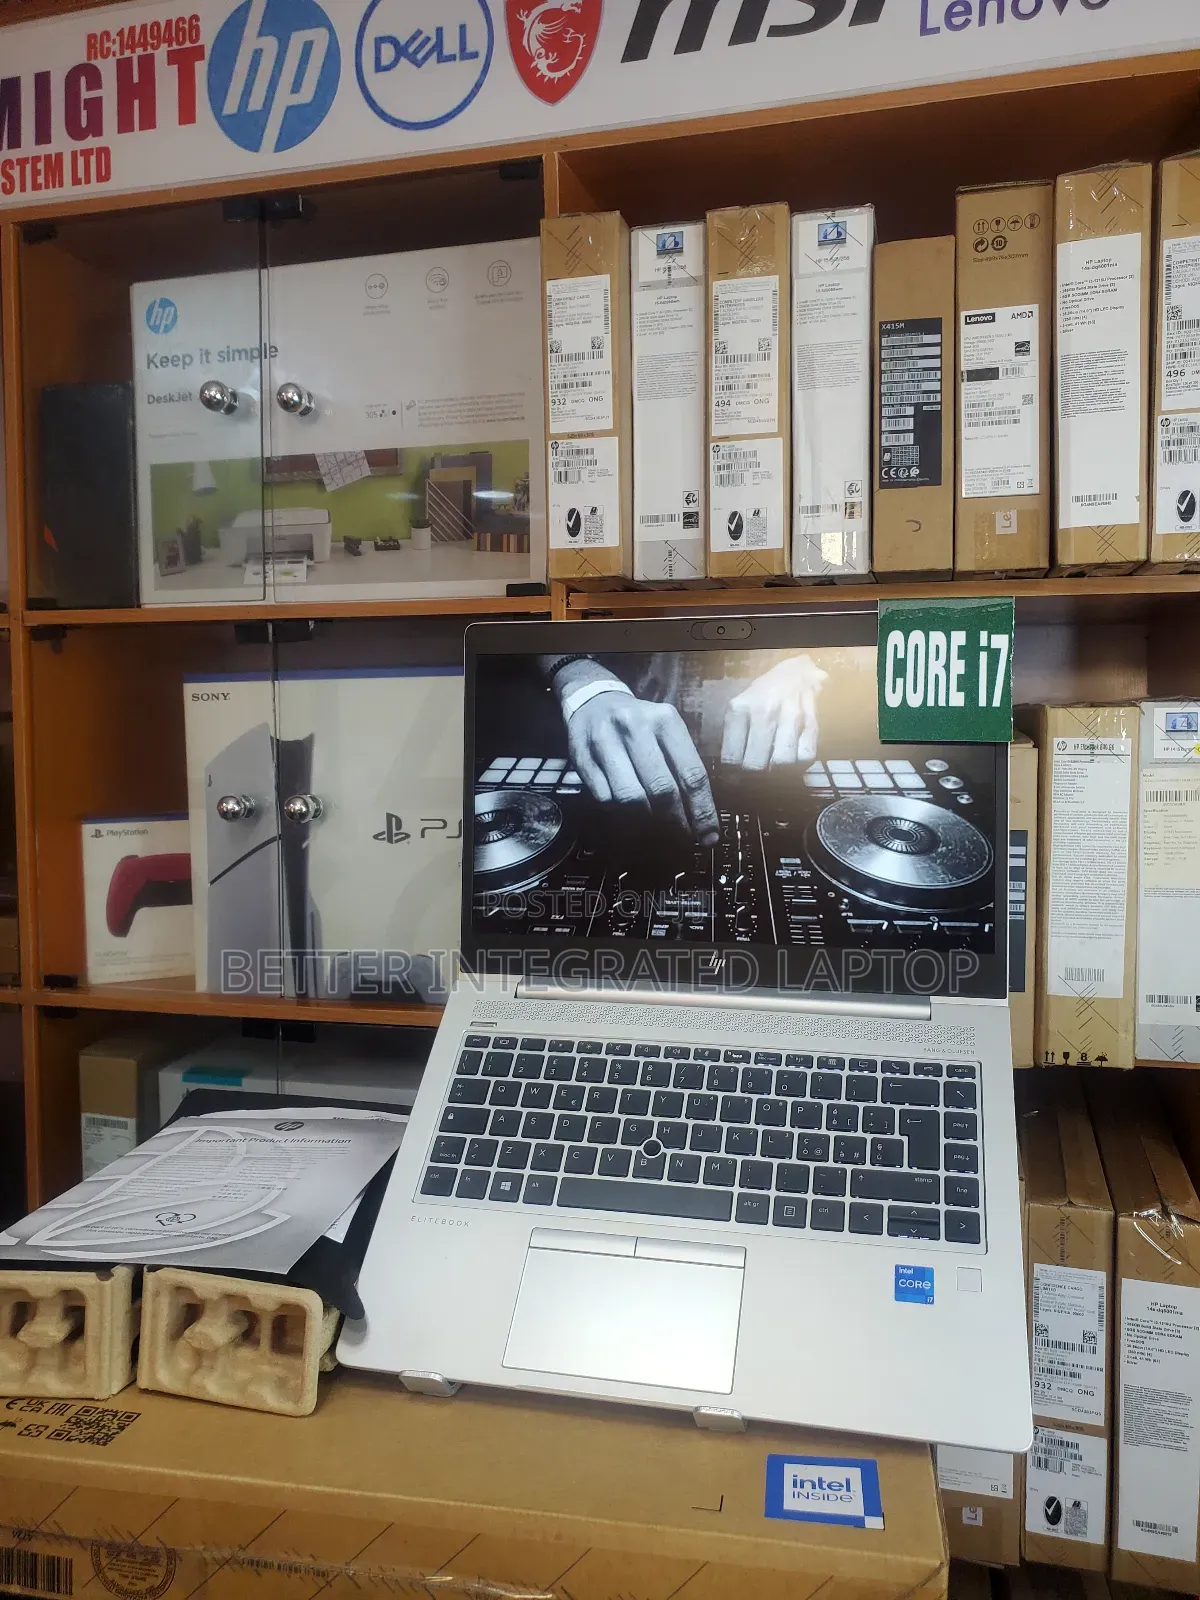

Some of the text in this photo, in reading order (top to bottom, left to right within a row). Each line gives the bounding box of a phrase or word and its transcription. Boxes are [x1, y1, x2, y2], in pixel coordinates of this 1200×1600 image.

[86, 14, 201, 62] RC:1449466
[373, 23, 480, 75] DELL
[70, 146, 112, 186] LTD
[149, 297, 176, 334] hp
[966, 315, 993, 323] Lenovo
[1010, 311, 1028, 320] AMD
[881, 322, 905, 331] X415M
[146, 342, 279, 370] Keep it simple
[1166, 369, 1186, 378] 496
[147, 391, 193, 405] DeskJet
[551, 398, 567, 406] 932
[715, 400, 731, 408] 494
[885, 629, 1010, 708] CORE i7
[191, 692, 230, 702] SONY
[106, 828, 149, 837] PlayStation
[497, 1085, 506, 1093] Q
[530, 1087, 540, 1095] W
[561, 1089, 568, 1097] E
[593, 1091, 600, 1099] R
[626, 1093, 633, 1101] T
[693, 1098, 701, 1106] U
[797, 1106, 804, 1114] P
[530, 1117, 537, 1125] S
[562, 1119, 570, 1127] D
[629, 1123, 637, 1132] G
[697, 1129, 704, 1137] J
[732, 1132, 740, 1141] K
[768, 1135, 774, 1143] L
[195, 1137, 247, 1145] Important
[814, 1147, 823, 1156] @
[505, 1146, 720, 1171] Z X C V B N M
[956, 1186, 968, 1194] fine
[411, 1215, 471, 1227] ELITEBOOK
[898, 1266, 914, 1275] intel
[1159, 1302, 1178, 1310] Laptop
[1034, 1381, 1052, 1391] 932
[1077, 1388, 1095, 1397] ONG
[791, 1474, 851, 1493] intel
